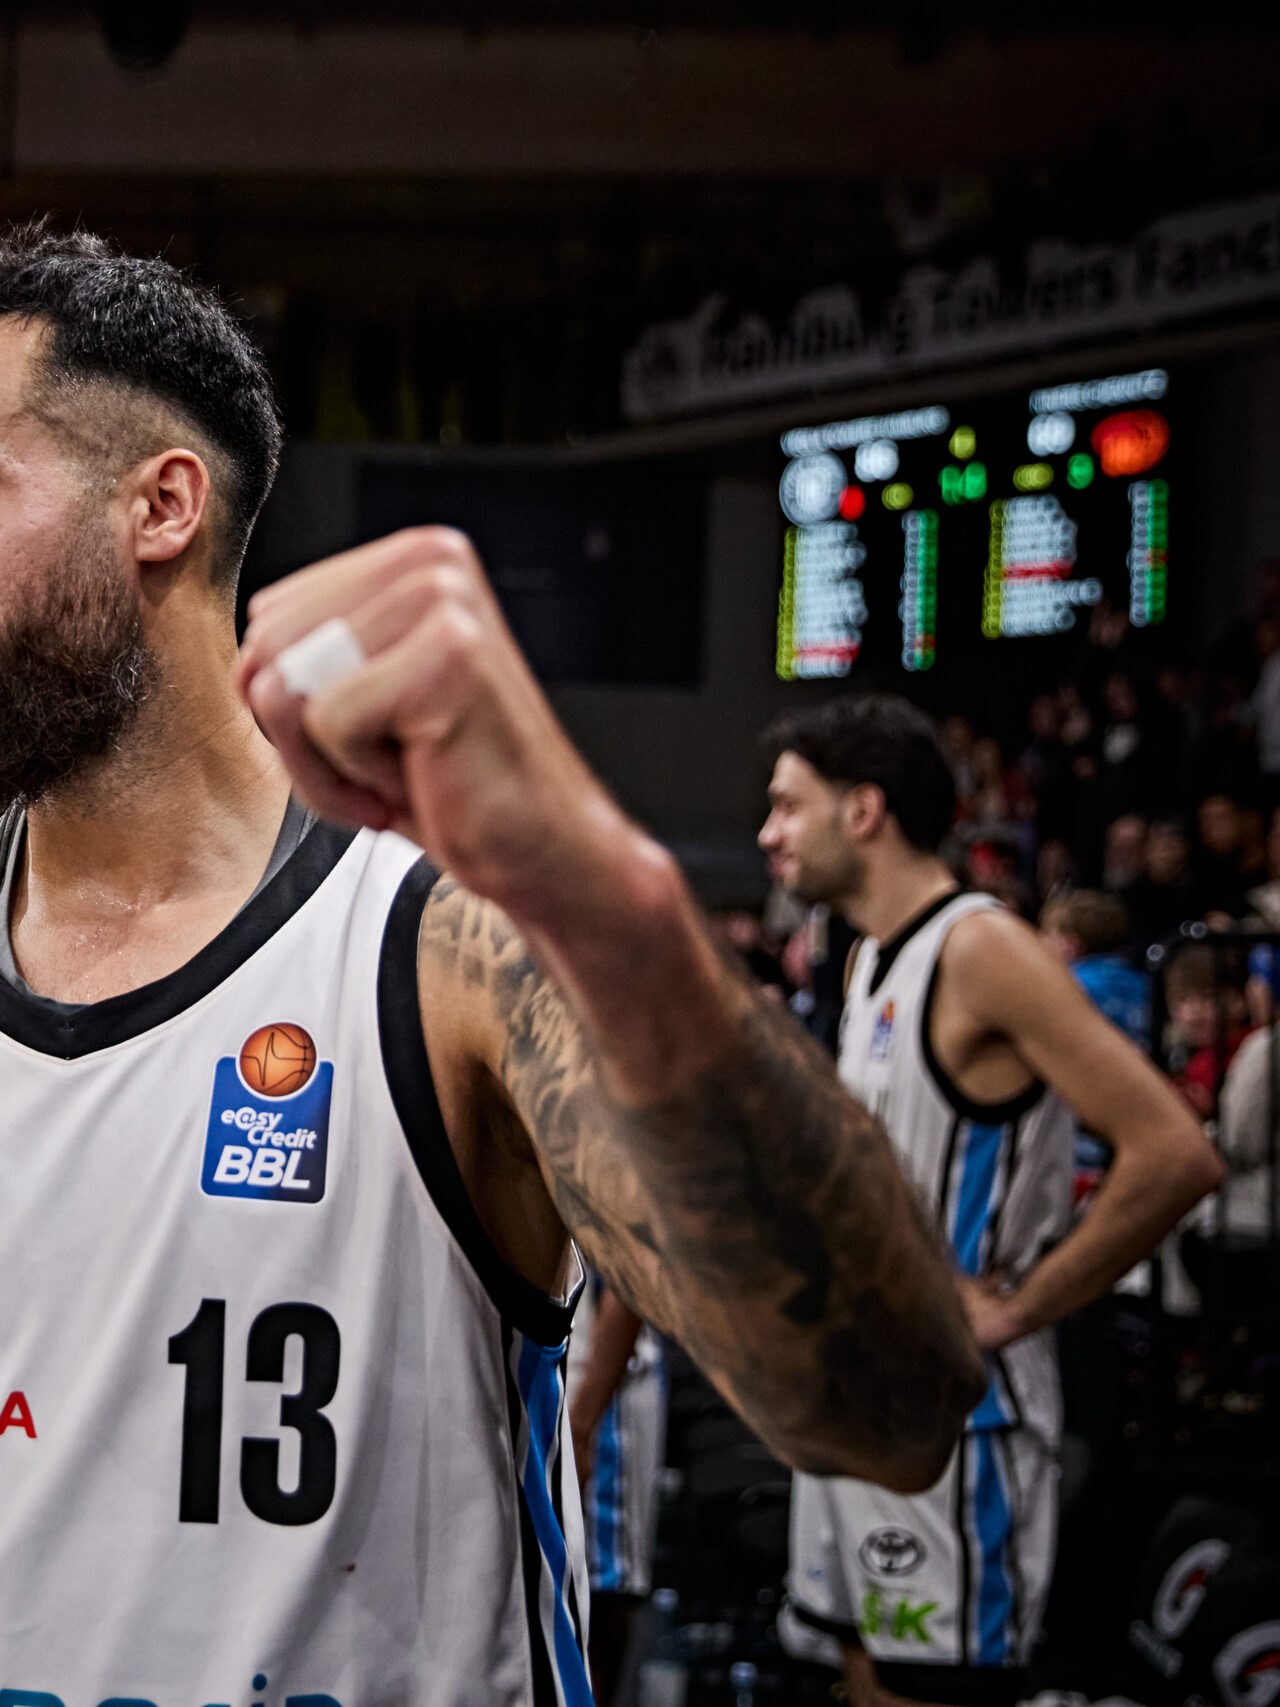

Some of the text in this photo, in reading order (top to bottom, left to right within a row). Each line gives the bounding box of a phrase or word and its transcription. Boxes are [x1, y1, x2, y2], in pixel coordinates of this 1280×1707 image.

[247, 1126, 317, 1149] Credit
[213, 1145, 310, 1189] BBL
[168, 1298, 341, 1526] 13
